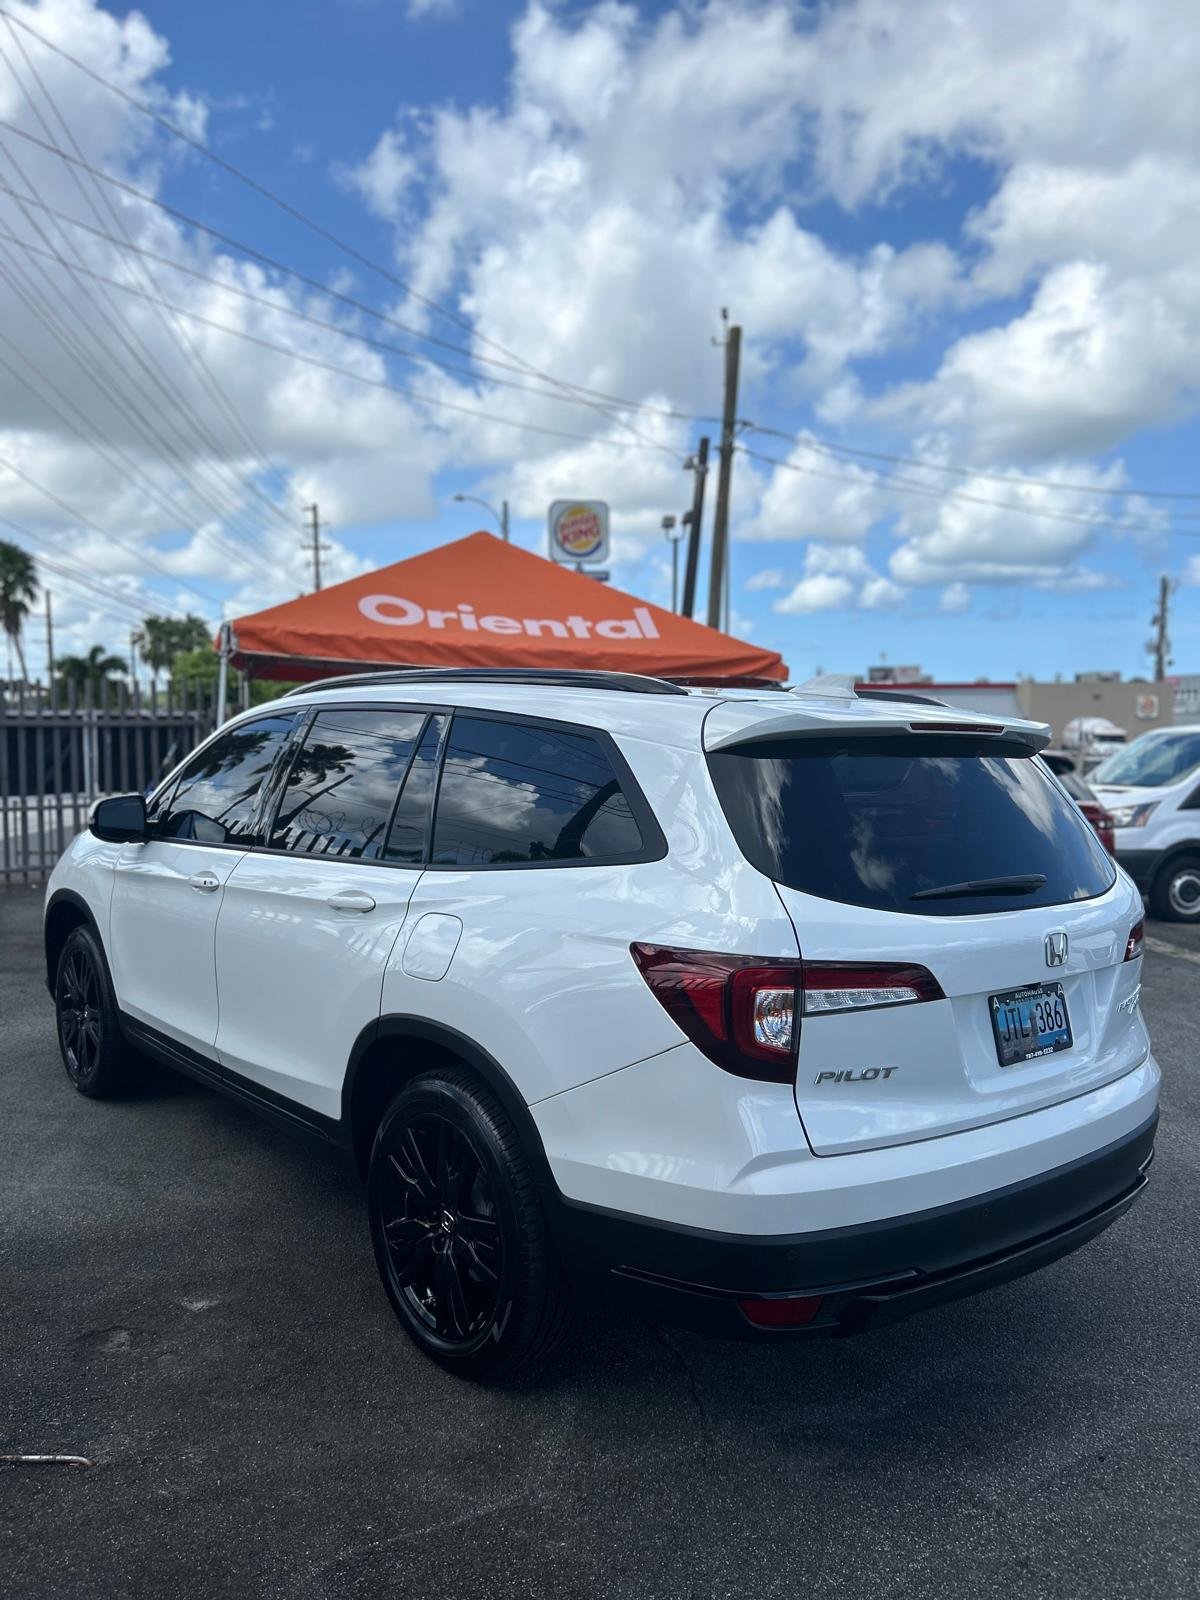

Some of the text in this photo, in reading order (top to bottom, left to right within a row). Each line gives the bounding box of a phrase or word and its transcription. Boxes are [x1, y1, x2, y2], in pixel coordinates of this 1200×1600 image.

[562, 523, 600, 545] KING
[357, 594, 660, 639] Oriental
[1003, 1000, 1063, 1042] JTL 386
[814, 1066, 899, 1085] PILOT
